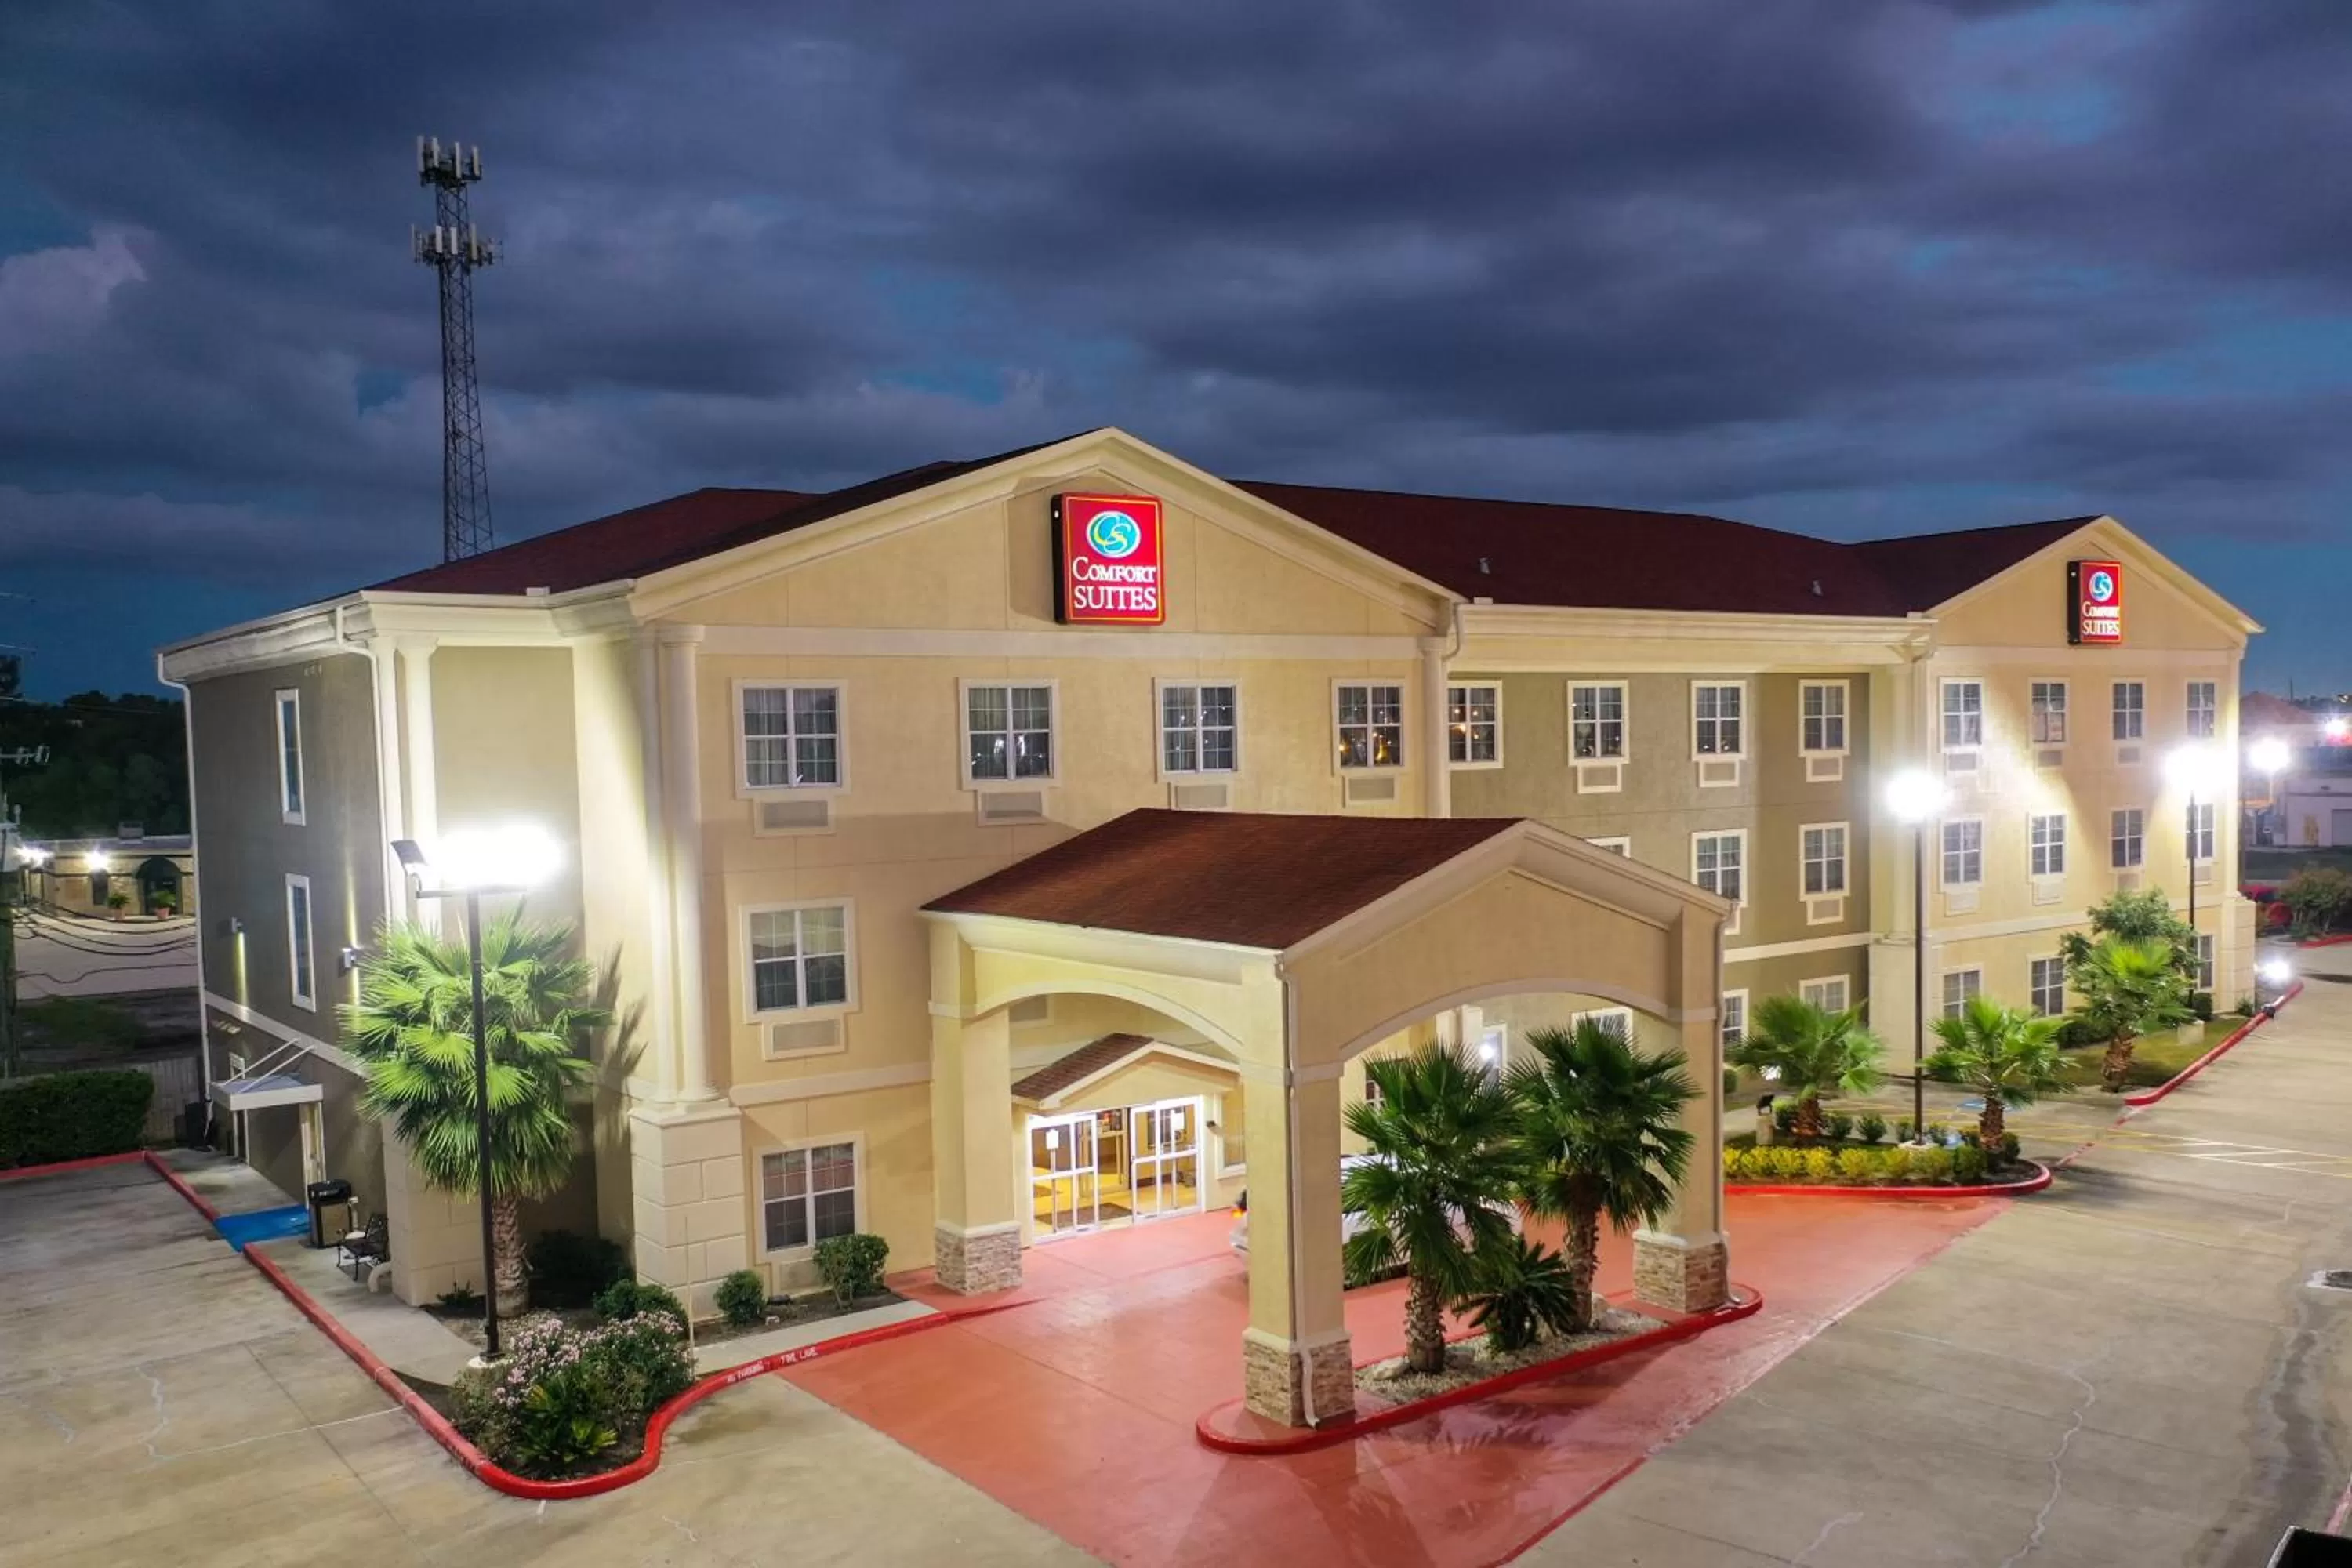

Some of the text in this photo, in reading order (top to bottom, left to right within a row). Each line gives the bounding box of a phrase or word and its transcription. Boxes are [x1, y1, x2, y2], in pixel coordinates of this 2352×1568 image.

[1072, 556, 1156, 582] COMFORT
[1073, 586, 1156, 610] SUITES
[2082, 601, 2120, 618] COMT
[800, 1346, 818, 1359] LE
